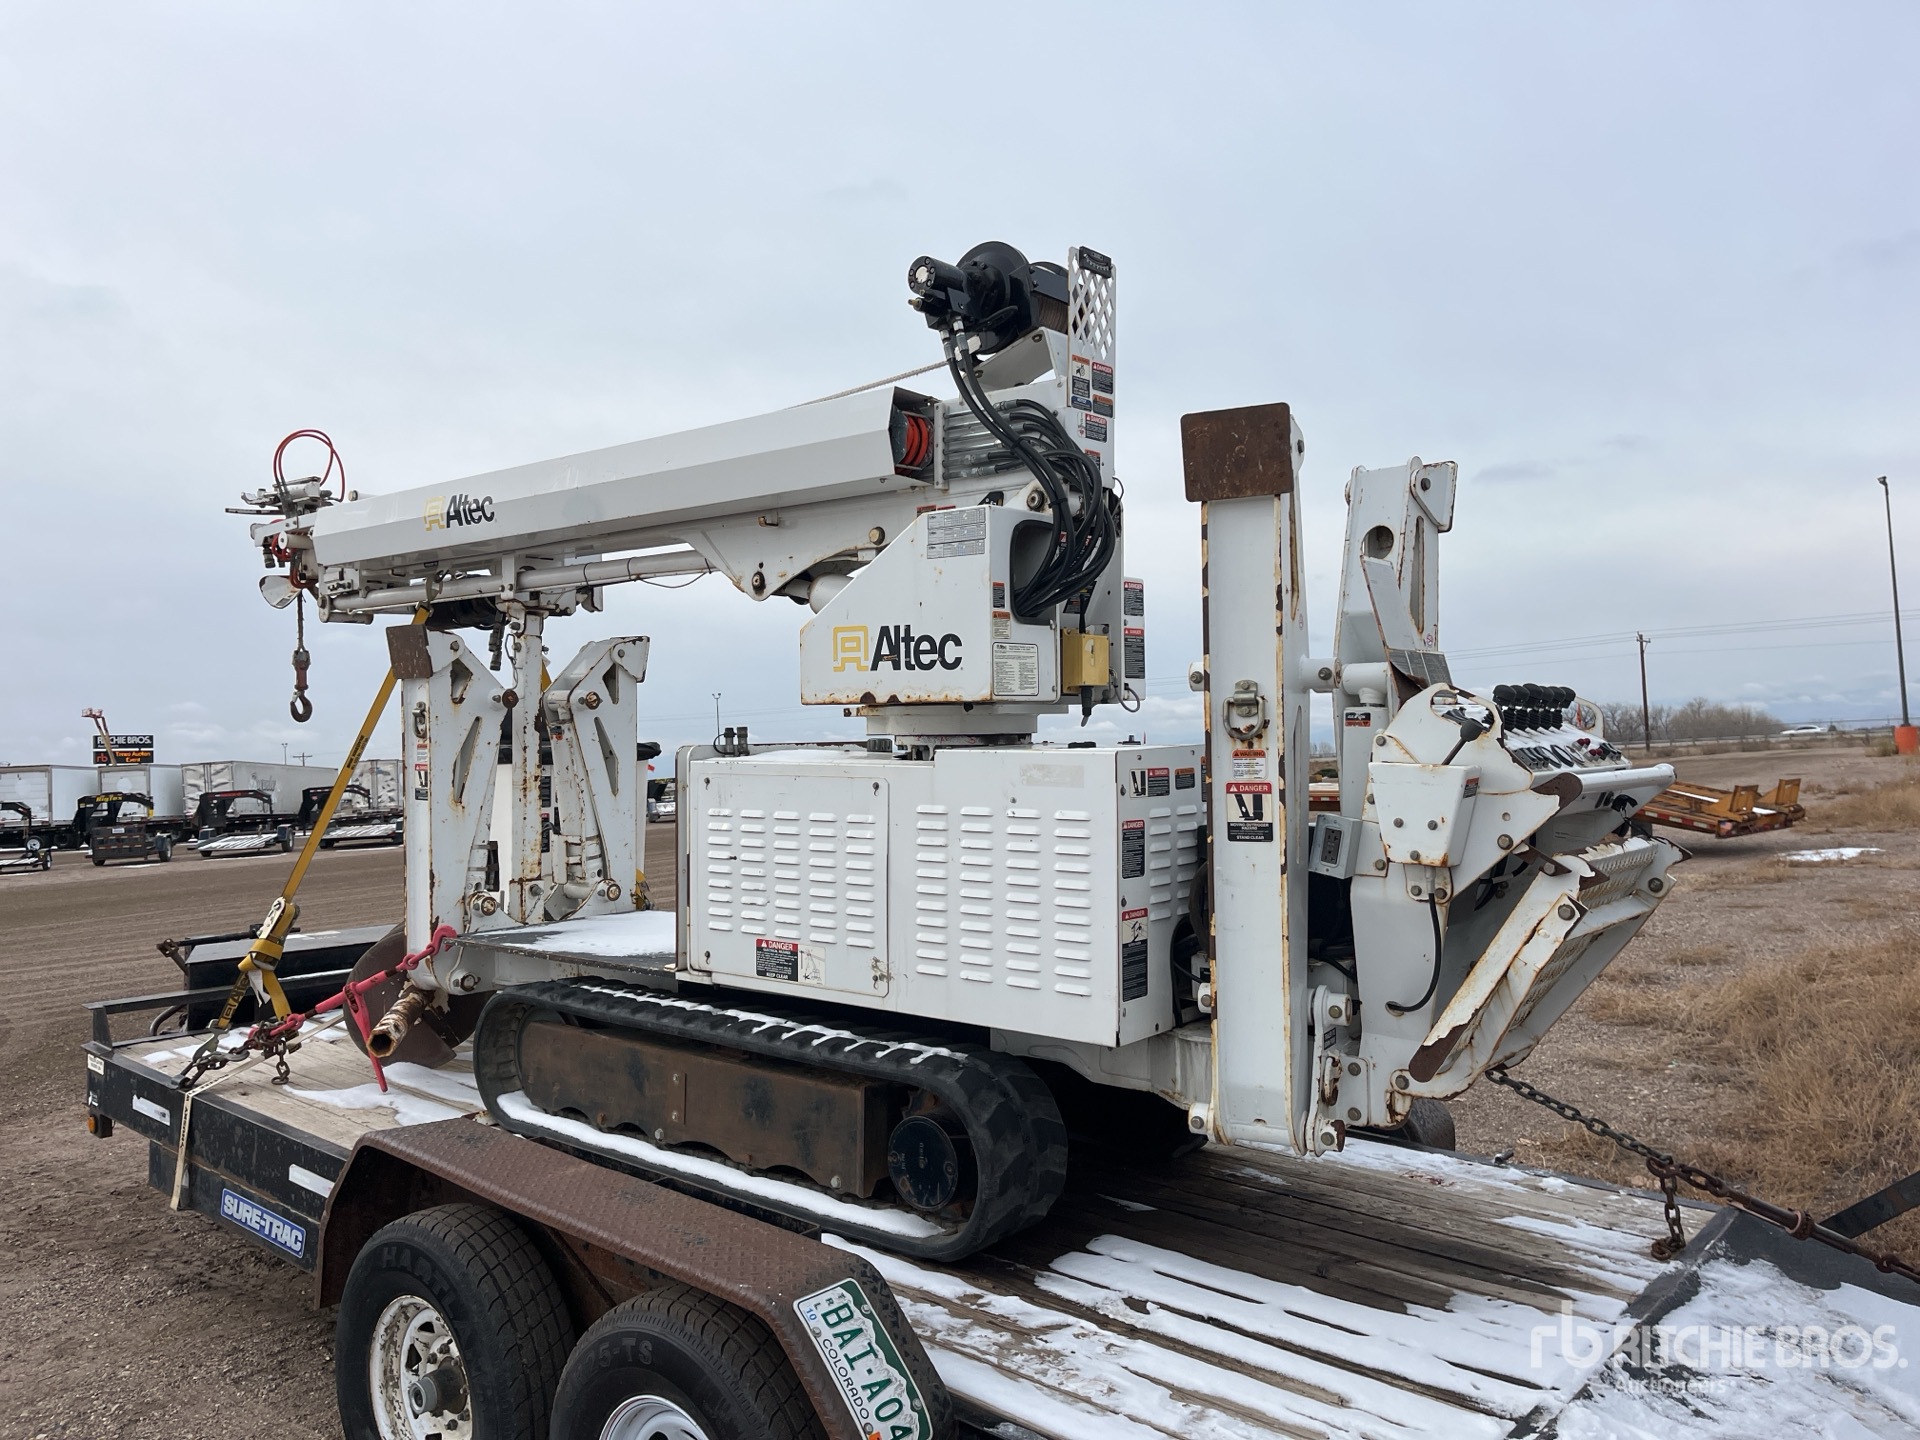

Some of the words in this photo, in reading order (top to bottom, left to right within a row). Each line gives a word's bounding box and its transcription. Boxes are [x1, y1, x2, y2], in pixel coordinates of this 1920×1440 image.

[446, 493, 495, 528] Altec
[870, 624, 963, 671] Altec
[768, 941, 793, 950] DANGER
[223, 1194, 303, 1252] SURE-TRAC
[822, 1338, 870, 1420] COLORADO
